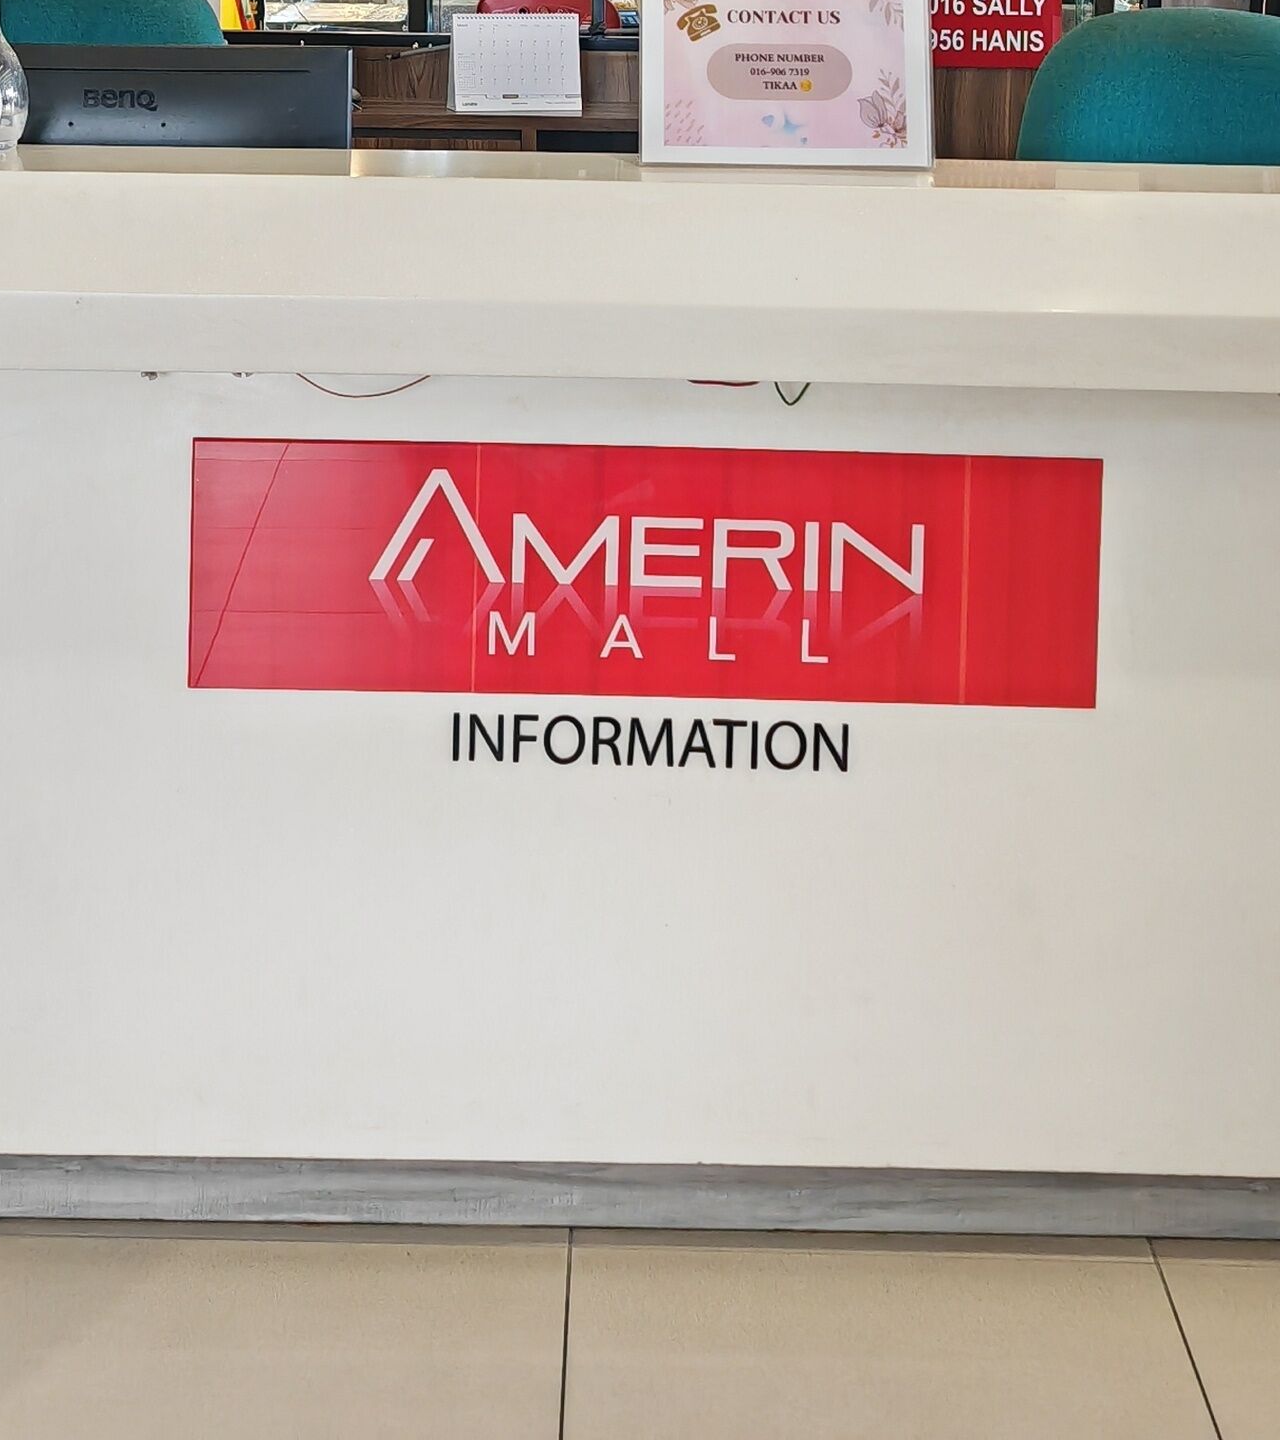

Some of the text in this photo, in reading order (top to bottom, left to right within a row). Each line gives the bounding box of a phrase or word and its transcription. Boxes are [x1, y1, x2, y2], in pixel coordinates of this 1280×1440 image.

[727, 9, 841, 26] CONTACT US
[972, 29, 1045, 52] HANIS
[734, 53, 825, 63] PHONE NUMBER
[749, 67, 787, 76] 016-906
[762, 81, 798, 91] TIKAA
[82, 88, 159, 112] BenQ
[367, 468, 925, 596] AMERIN
[486, 611, 830, 665] MALL
[450, 711, 852, 774] INFORMATION
